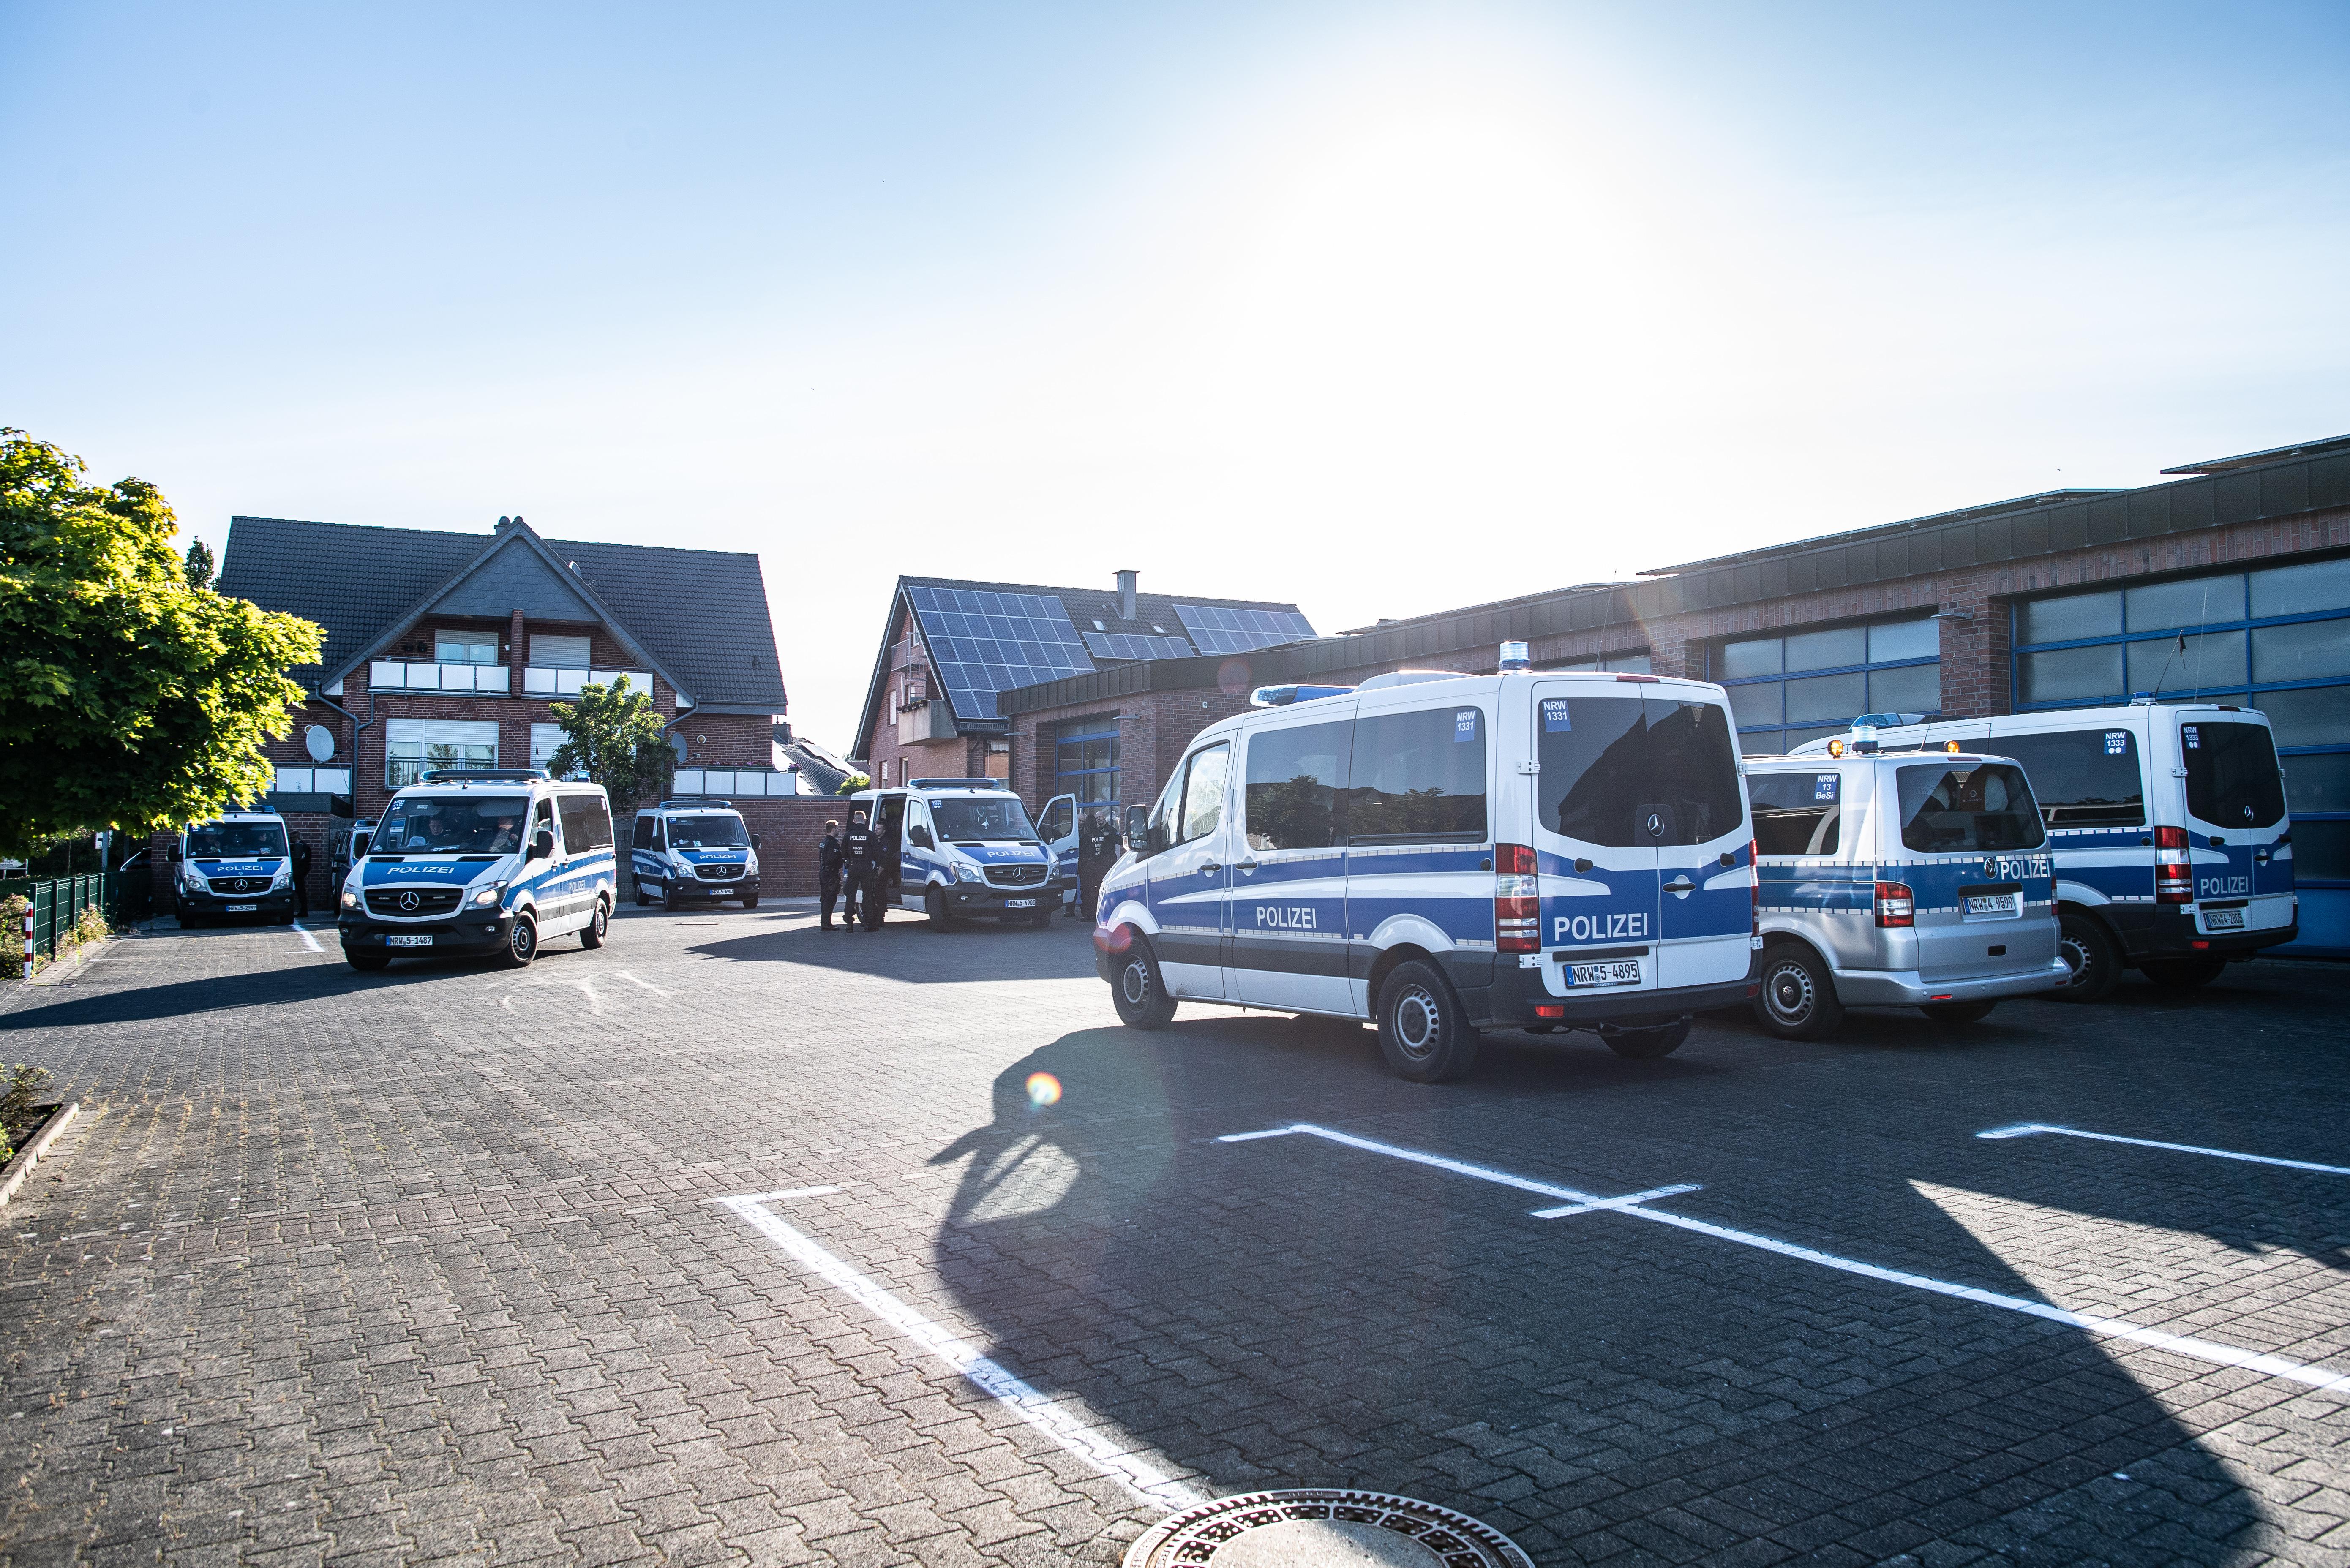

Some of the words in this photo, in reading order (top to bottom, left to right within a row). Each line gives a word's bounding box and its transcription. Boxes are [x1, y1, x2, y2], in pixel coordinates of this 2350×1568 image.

[1543, 701, 1566, 710] NRW
[1457, 711, 1475, 721] NRW
[1546, 711, 1568, 721] 1331
[1458, 721, 1474, 732] 1331
[387, 866, 455, 874] POLIZEI
[2000, 859, 2050, 880] POLIZEI
[568, 880, 585, 894] POLIZEI
[2200, 876, 2248, 895] POLIZEI
[1257, 906, 1317, 928] POLIZEI
[1554, 912, 1648, 941] POLIZEI
[406, 936, 432, 945] 5-1487
[1572, 966, 1594, 983] NRW
[1599, 963, 1638, 980] 5-4895
